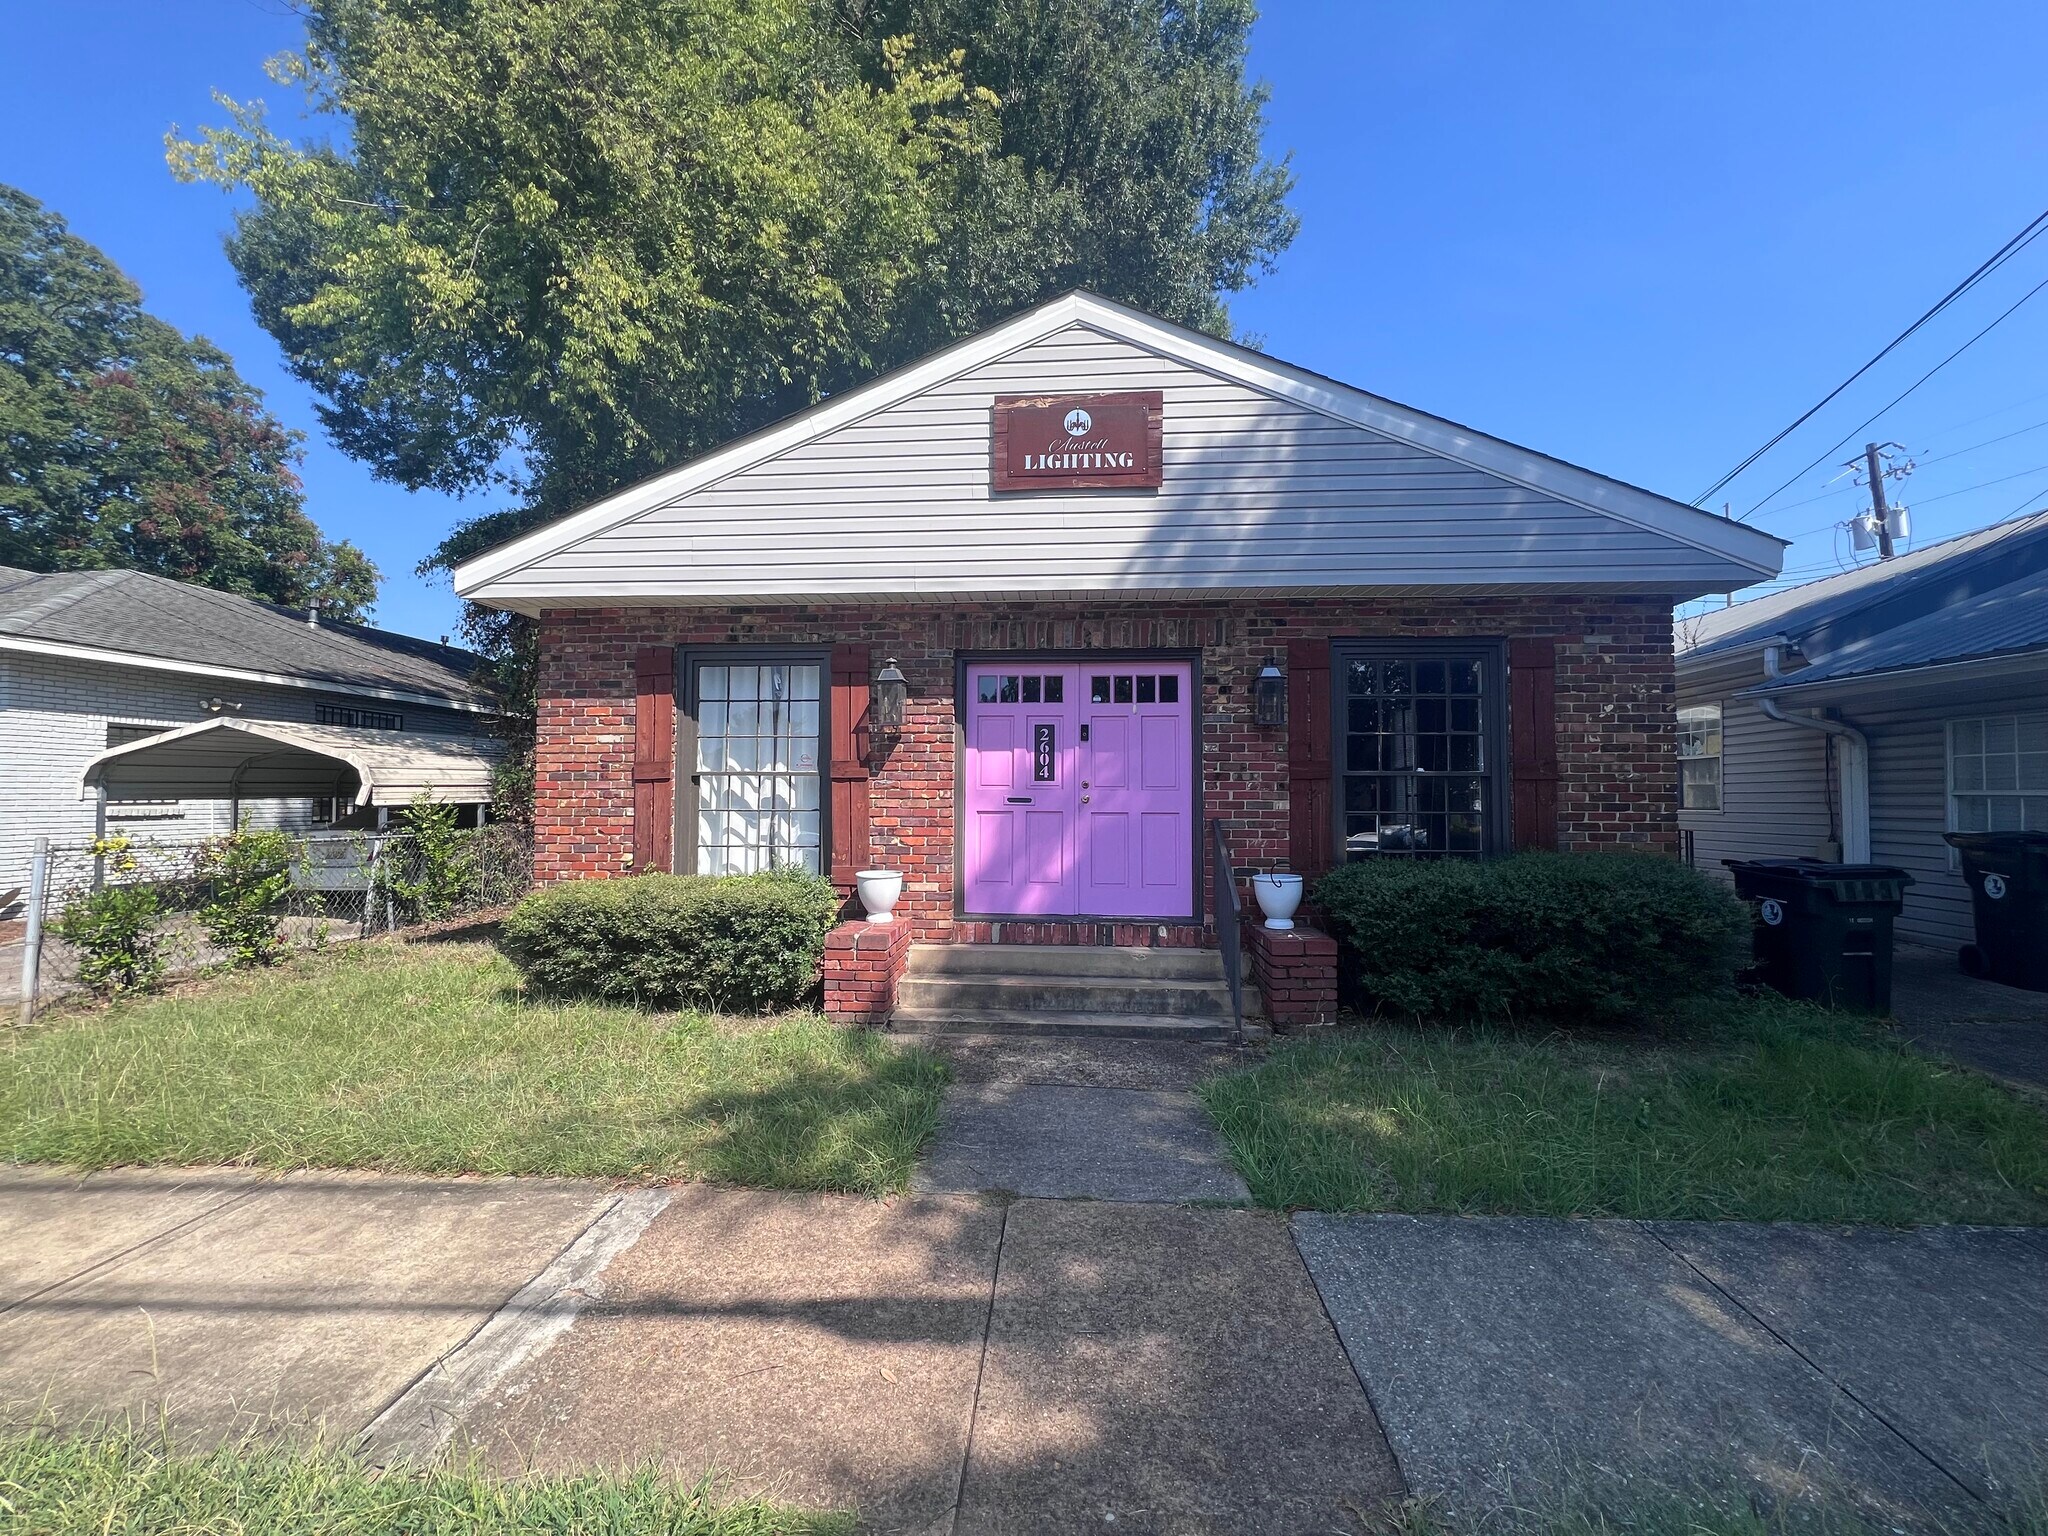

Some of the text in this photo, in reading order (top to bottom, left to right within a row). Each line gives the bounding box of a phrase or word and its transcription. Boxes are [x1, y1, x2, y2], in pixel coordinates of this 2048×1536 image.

[1048, 436, 1109, 453] Austell
[1024, 452, 1134, 470] LIGHTING
[1039, 728, 1050, 778] 2604
